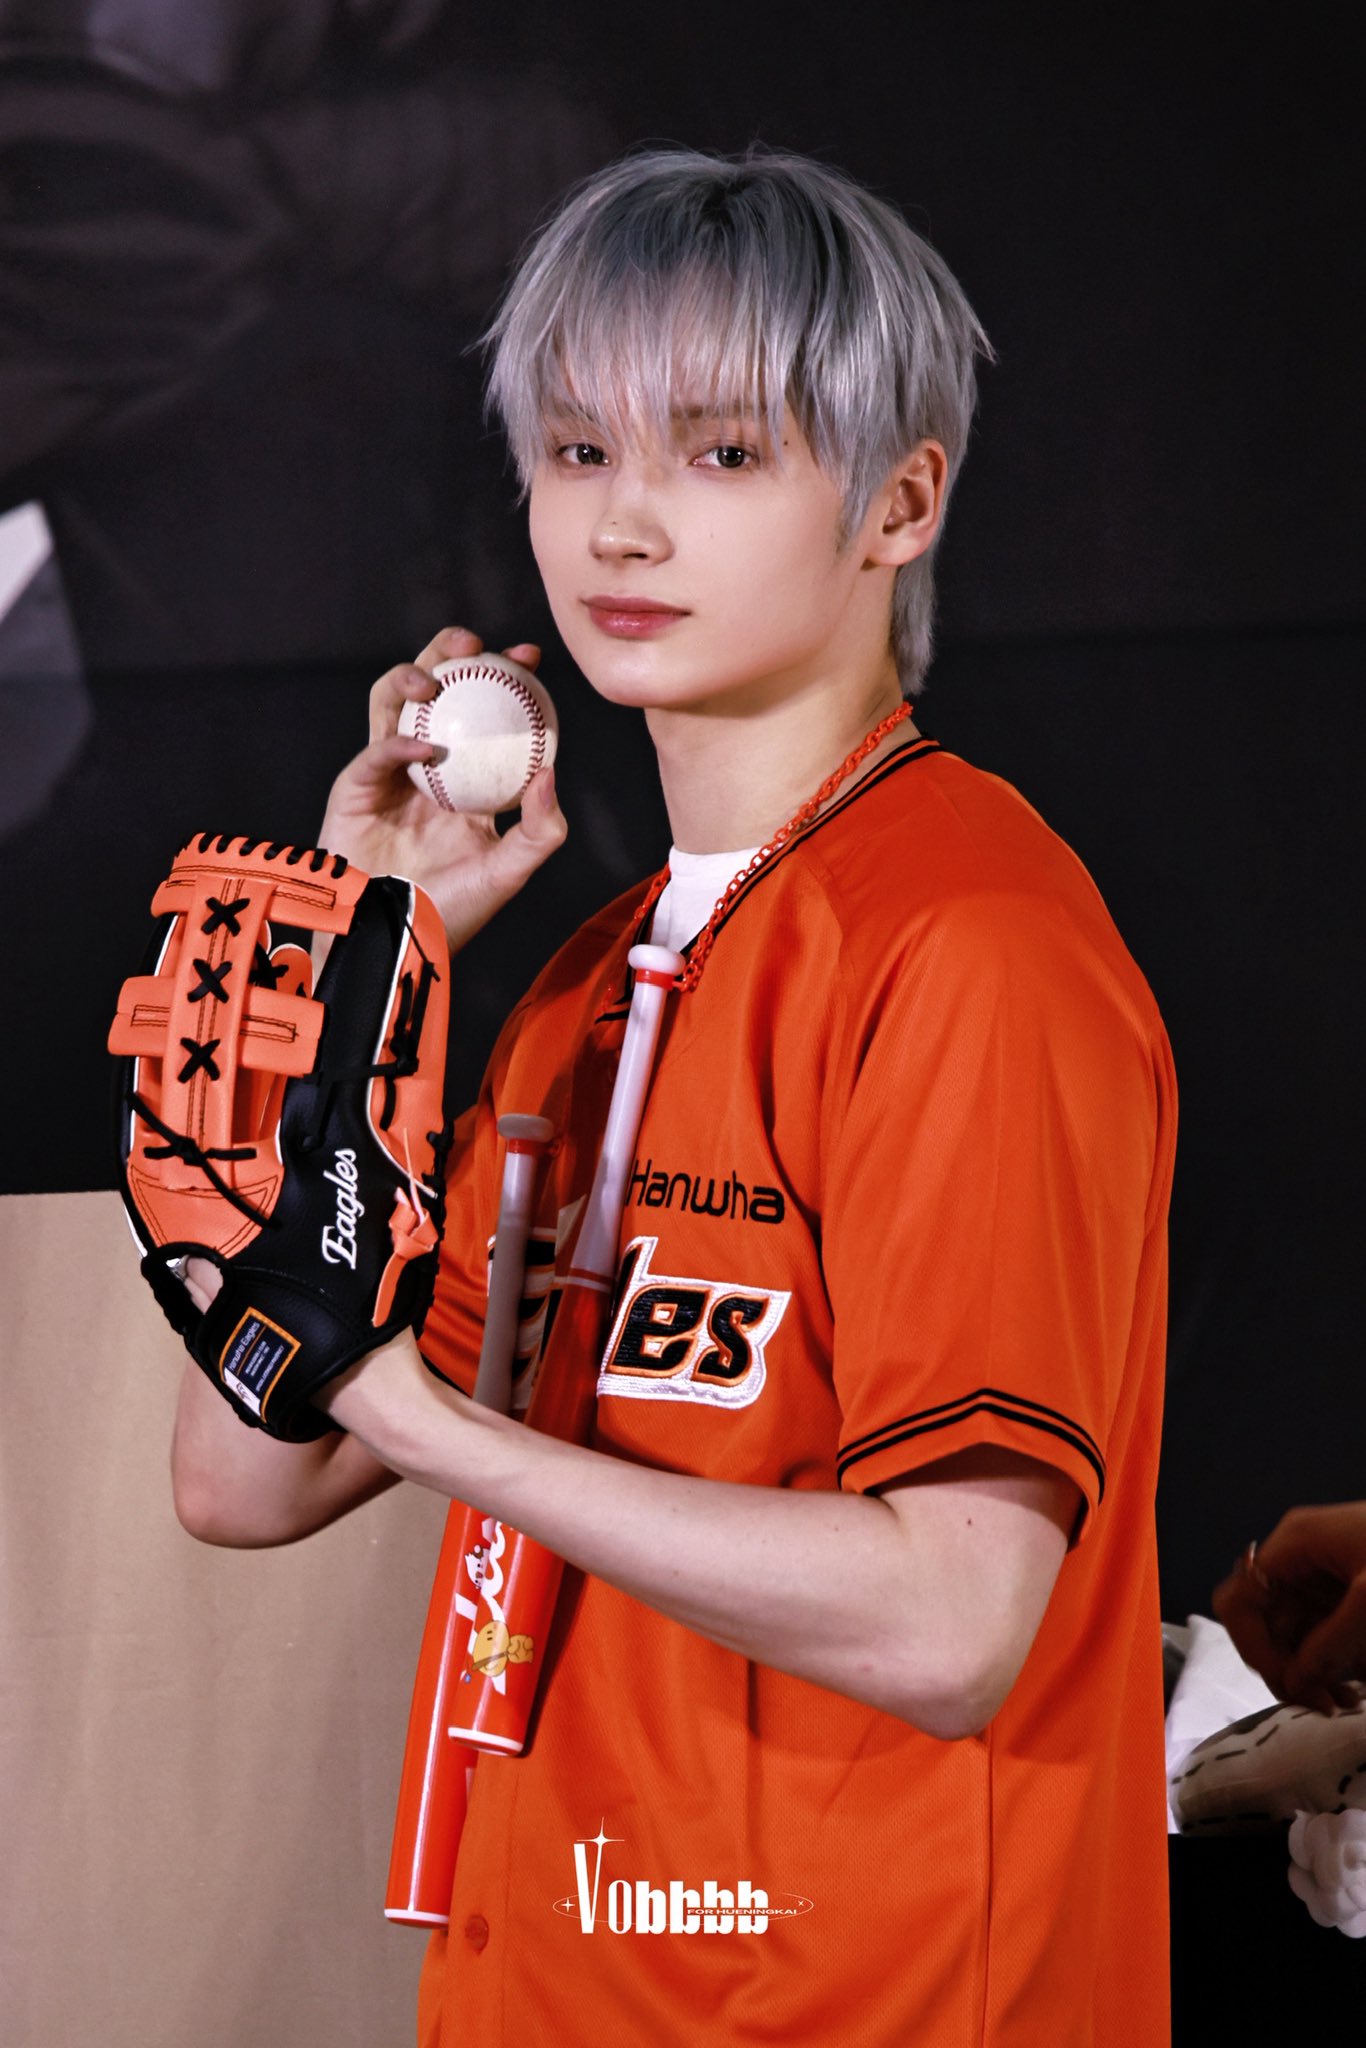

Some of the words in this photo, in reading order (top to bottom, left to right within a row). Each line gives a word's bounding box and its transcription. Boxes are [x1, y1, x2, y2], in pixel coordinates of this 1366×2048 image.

[321, 1148, 365, 1270] Eagles
[625, 1159, 785, 1225] Hanwha
[240, 1321, 260, 1346] Eagles
